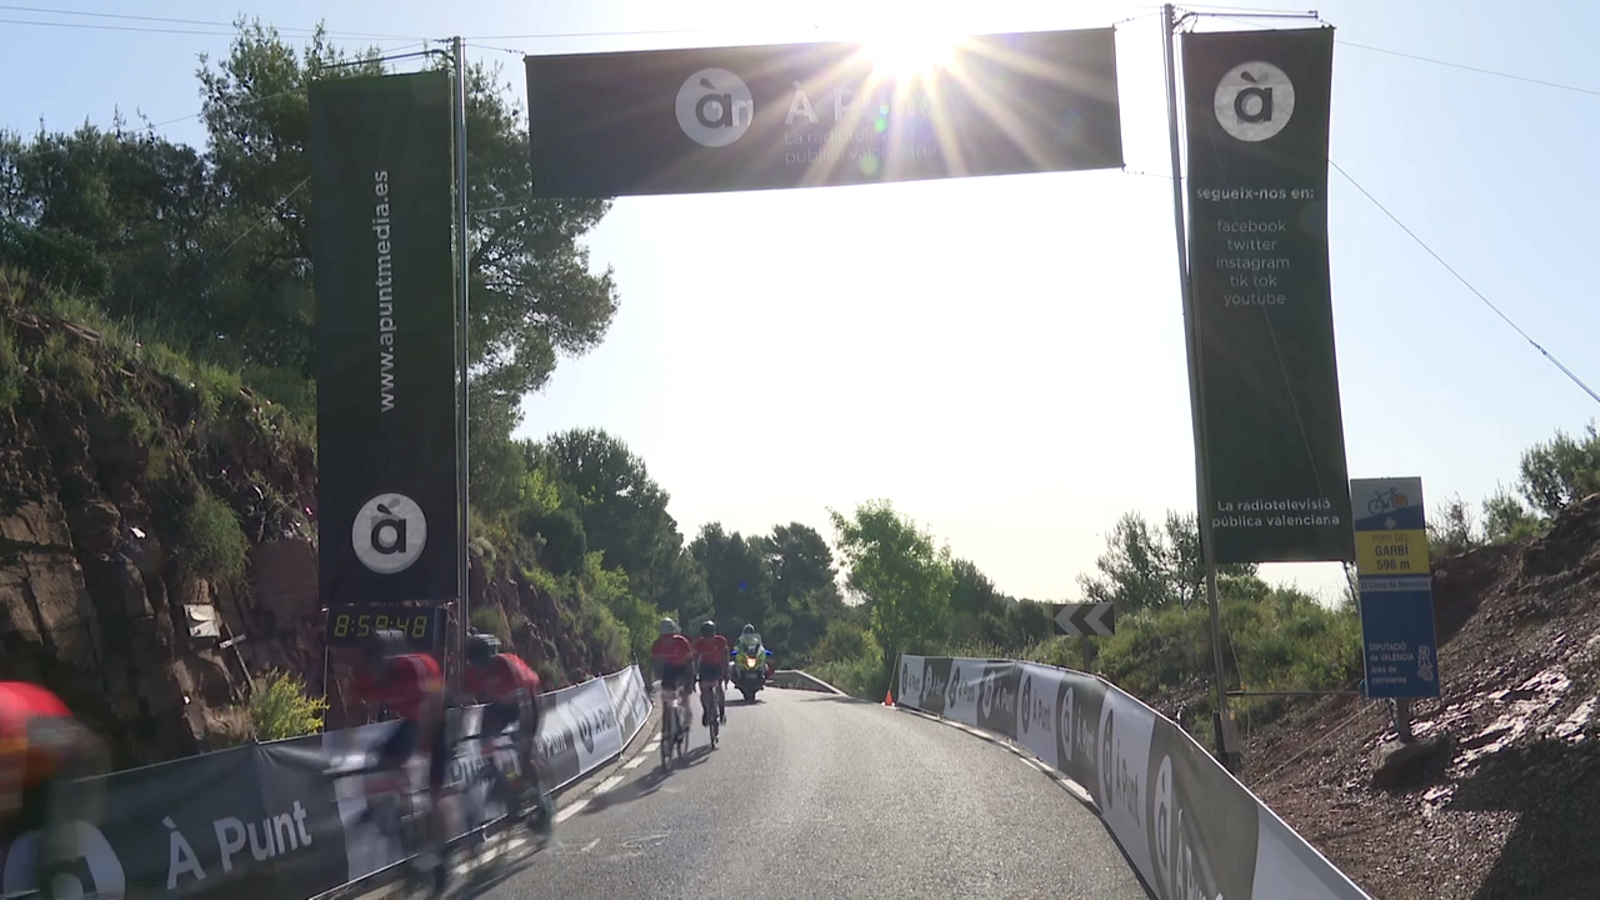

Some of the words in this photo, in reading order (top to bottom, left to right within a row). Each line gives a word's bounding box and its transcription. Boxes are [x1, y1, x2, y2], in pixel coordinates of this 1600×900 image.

[785, 80, 817, 124] À
[785, 131, 803, 145] La
[1197, 187, 1286, 201] segueix-nos
[1291, 187, 1314, 200] en:
[1217, 219, 1287, 234] facebook
[1227, 237, 1277, 251] twitter
[1216, 255, 1290, 271] instagram
[1230, 273, 1249, 288] tik
[1253, 273, 1277, 288] tok
[372, 170, 396, 412] www.apuntmedia.es
[1223, 291, 1286, 307] youtube
[1217, 500, 1234, 512] La
[1237, 497, 1332, 512] radiotelevisió
[1212, 514, 1263, 529] pública
[1266, 514, 1341, 527] valenciana
[1372, 534, 1392, 543] PORT
[1376, 559, 1397, 570] 596
[1400, 560, 1411, 570] m
[1369, 641, 1407, 652] DIPUTACIÓ
[162, 815, 208, 890] À
[213, 800, 313, 872] Punt
